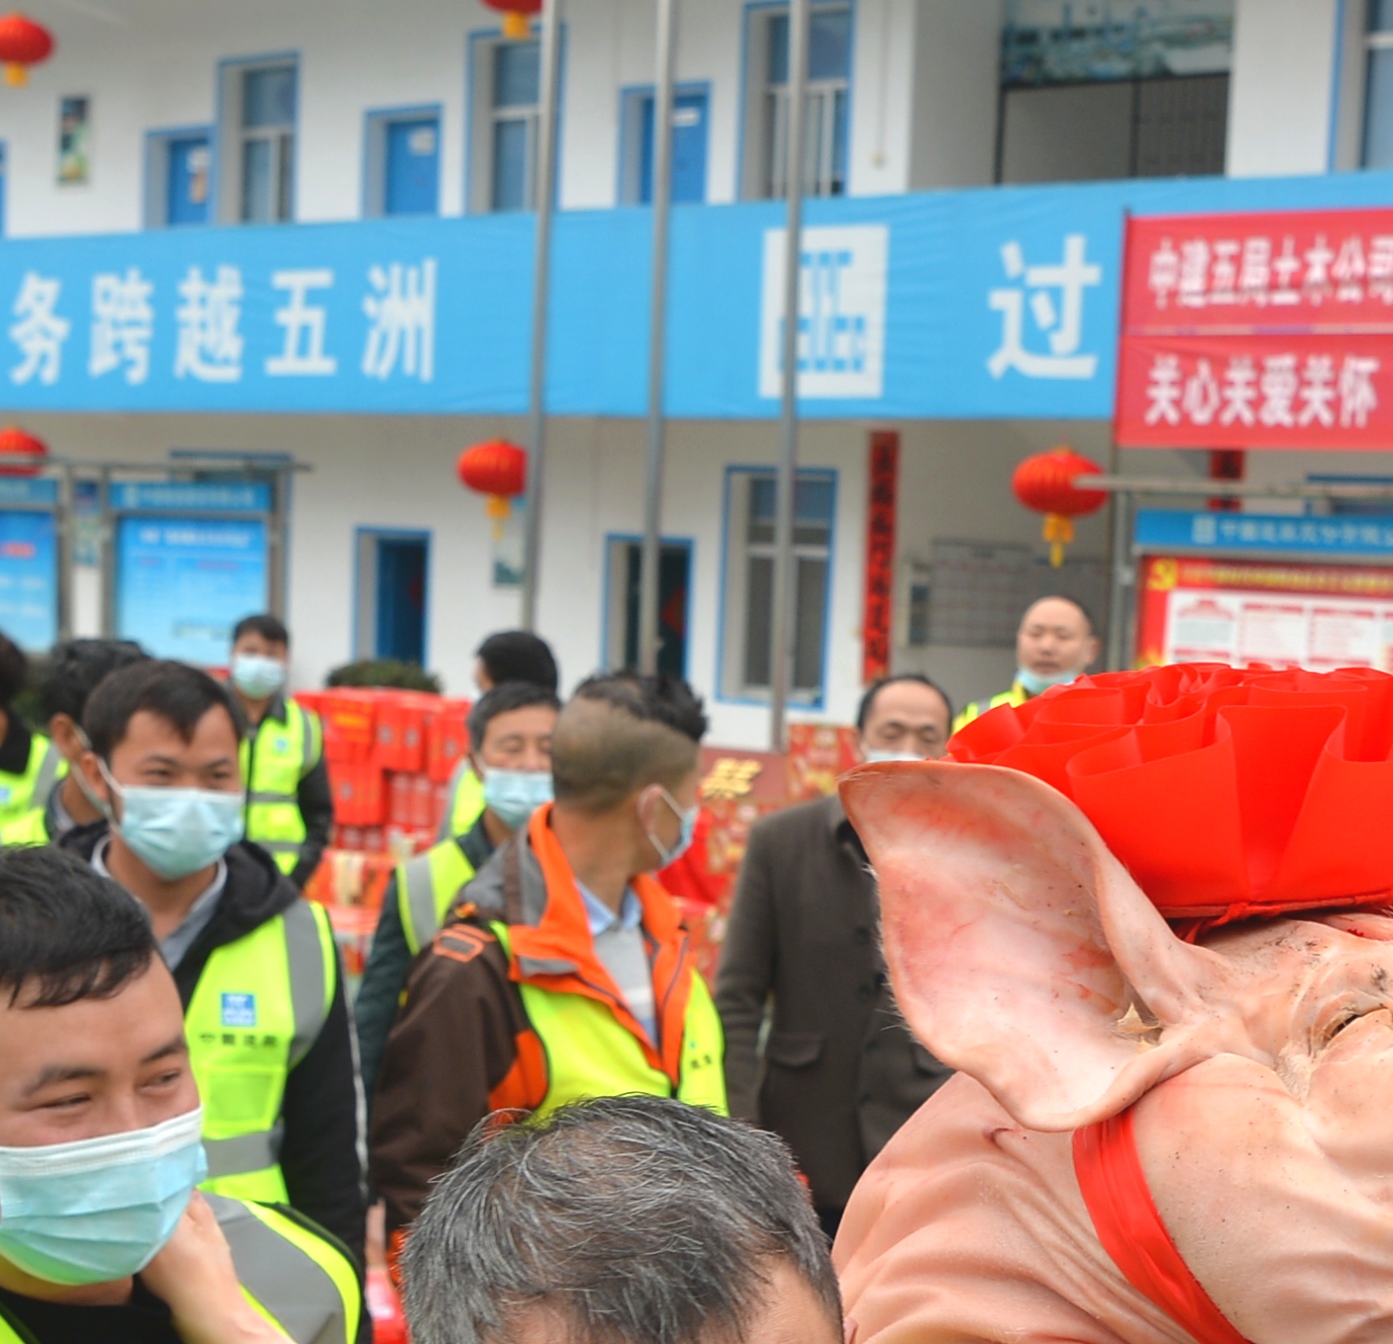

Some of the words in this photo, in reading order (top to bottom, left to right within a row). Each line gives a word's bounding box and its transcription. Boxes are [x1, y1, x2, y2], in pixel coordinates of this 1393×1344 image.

[985, 233, 1103, 381] 过
[1144, 353, 1380, 429] 关心关爱关怀
